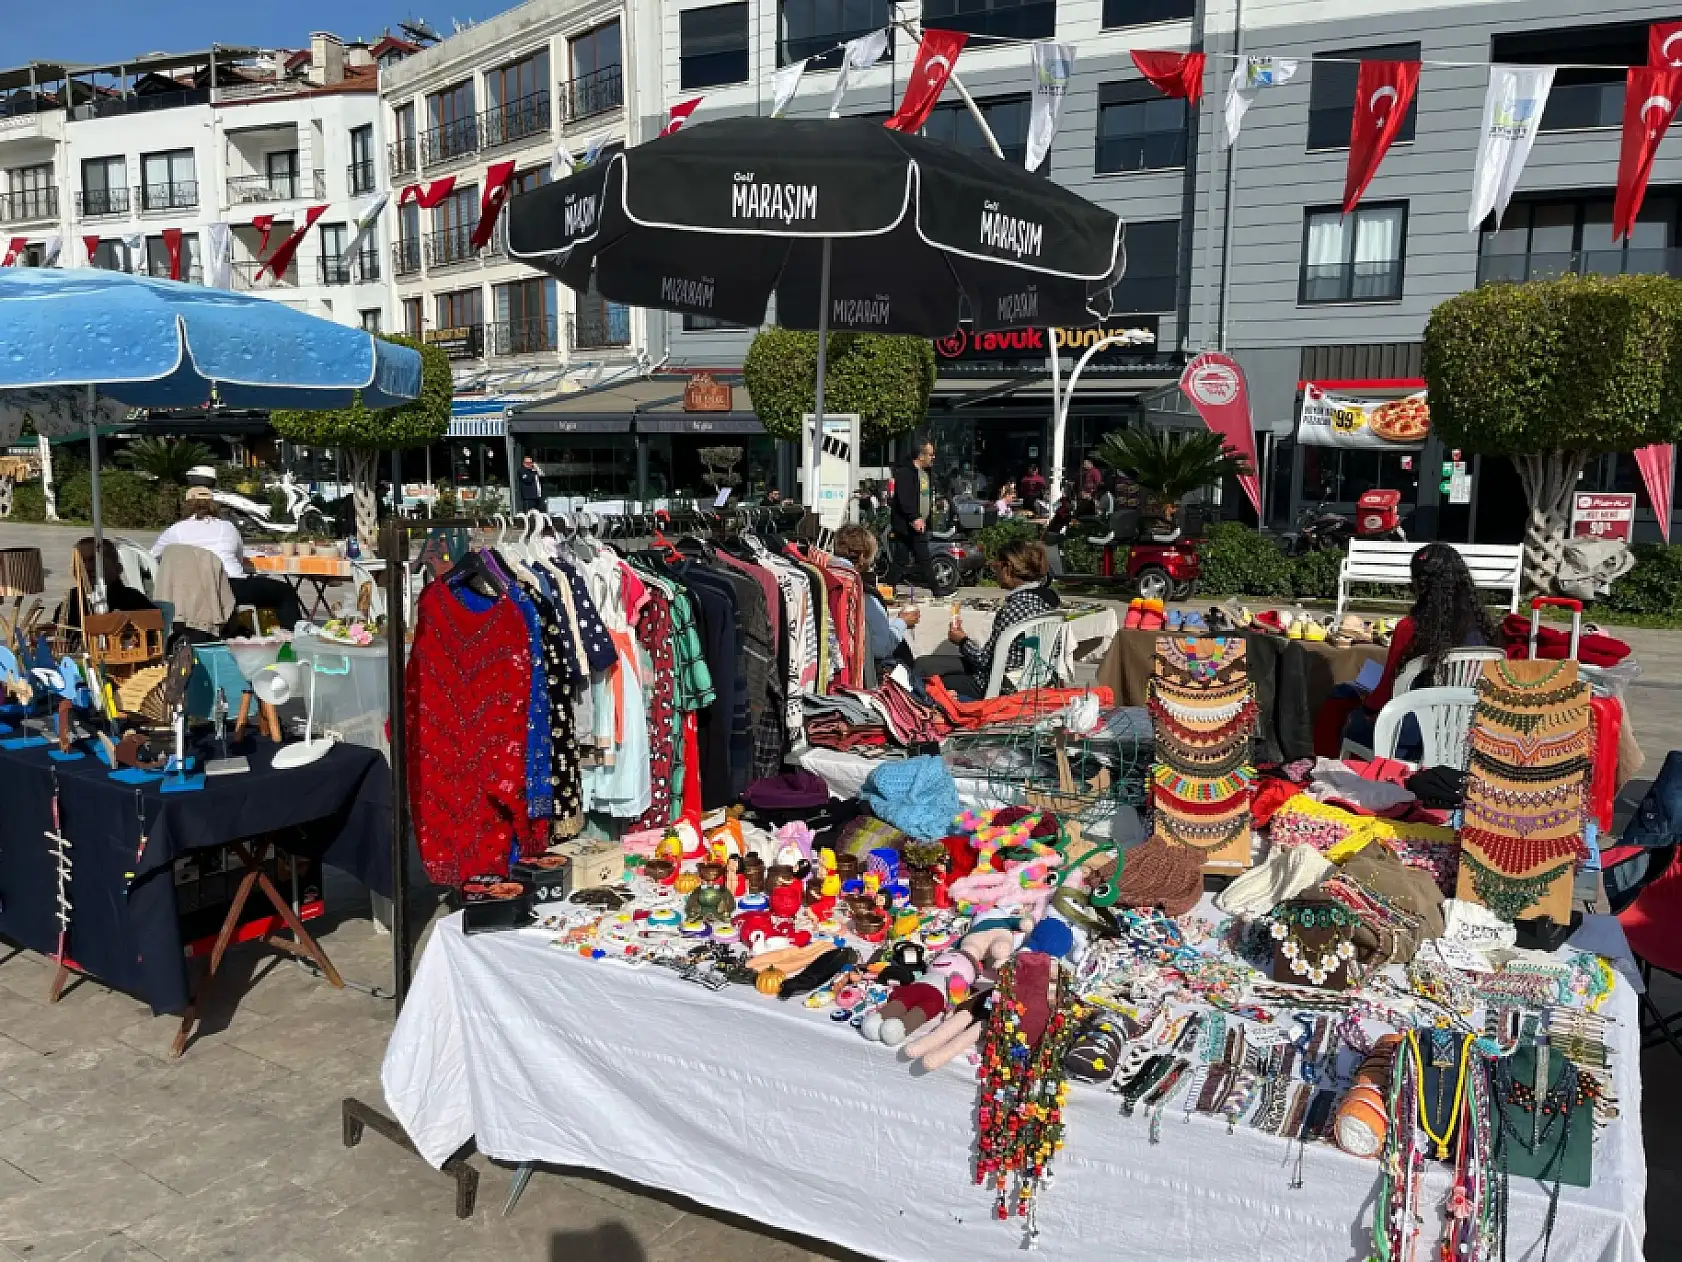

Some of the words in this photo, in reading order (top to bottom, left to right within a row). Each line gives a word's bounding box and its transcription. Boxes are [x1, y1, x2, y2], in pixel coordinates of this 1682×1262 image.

[731, 183, 818, 225] MARAŞIM
[980, 210, 1043, 258] MARAŞIM
[970, 324, 1044, 350] Tavuk
